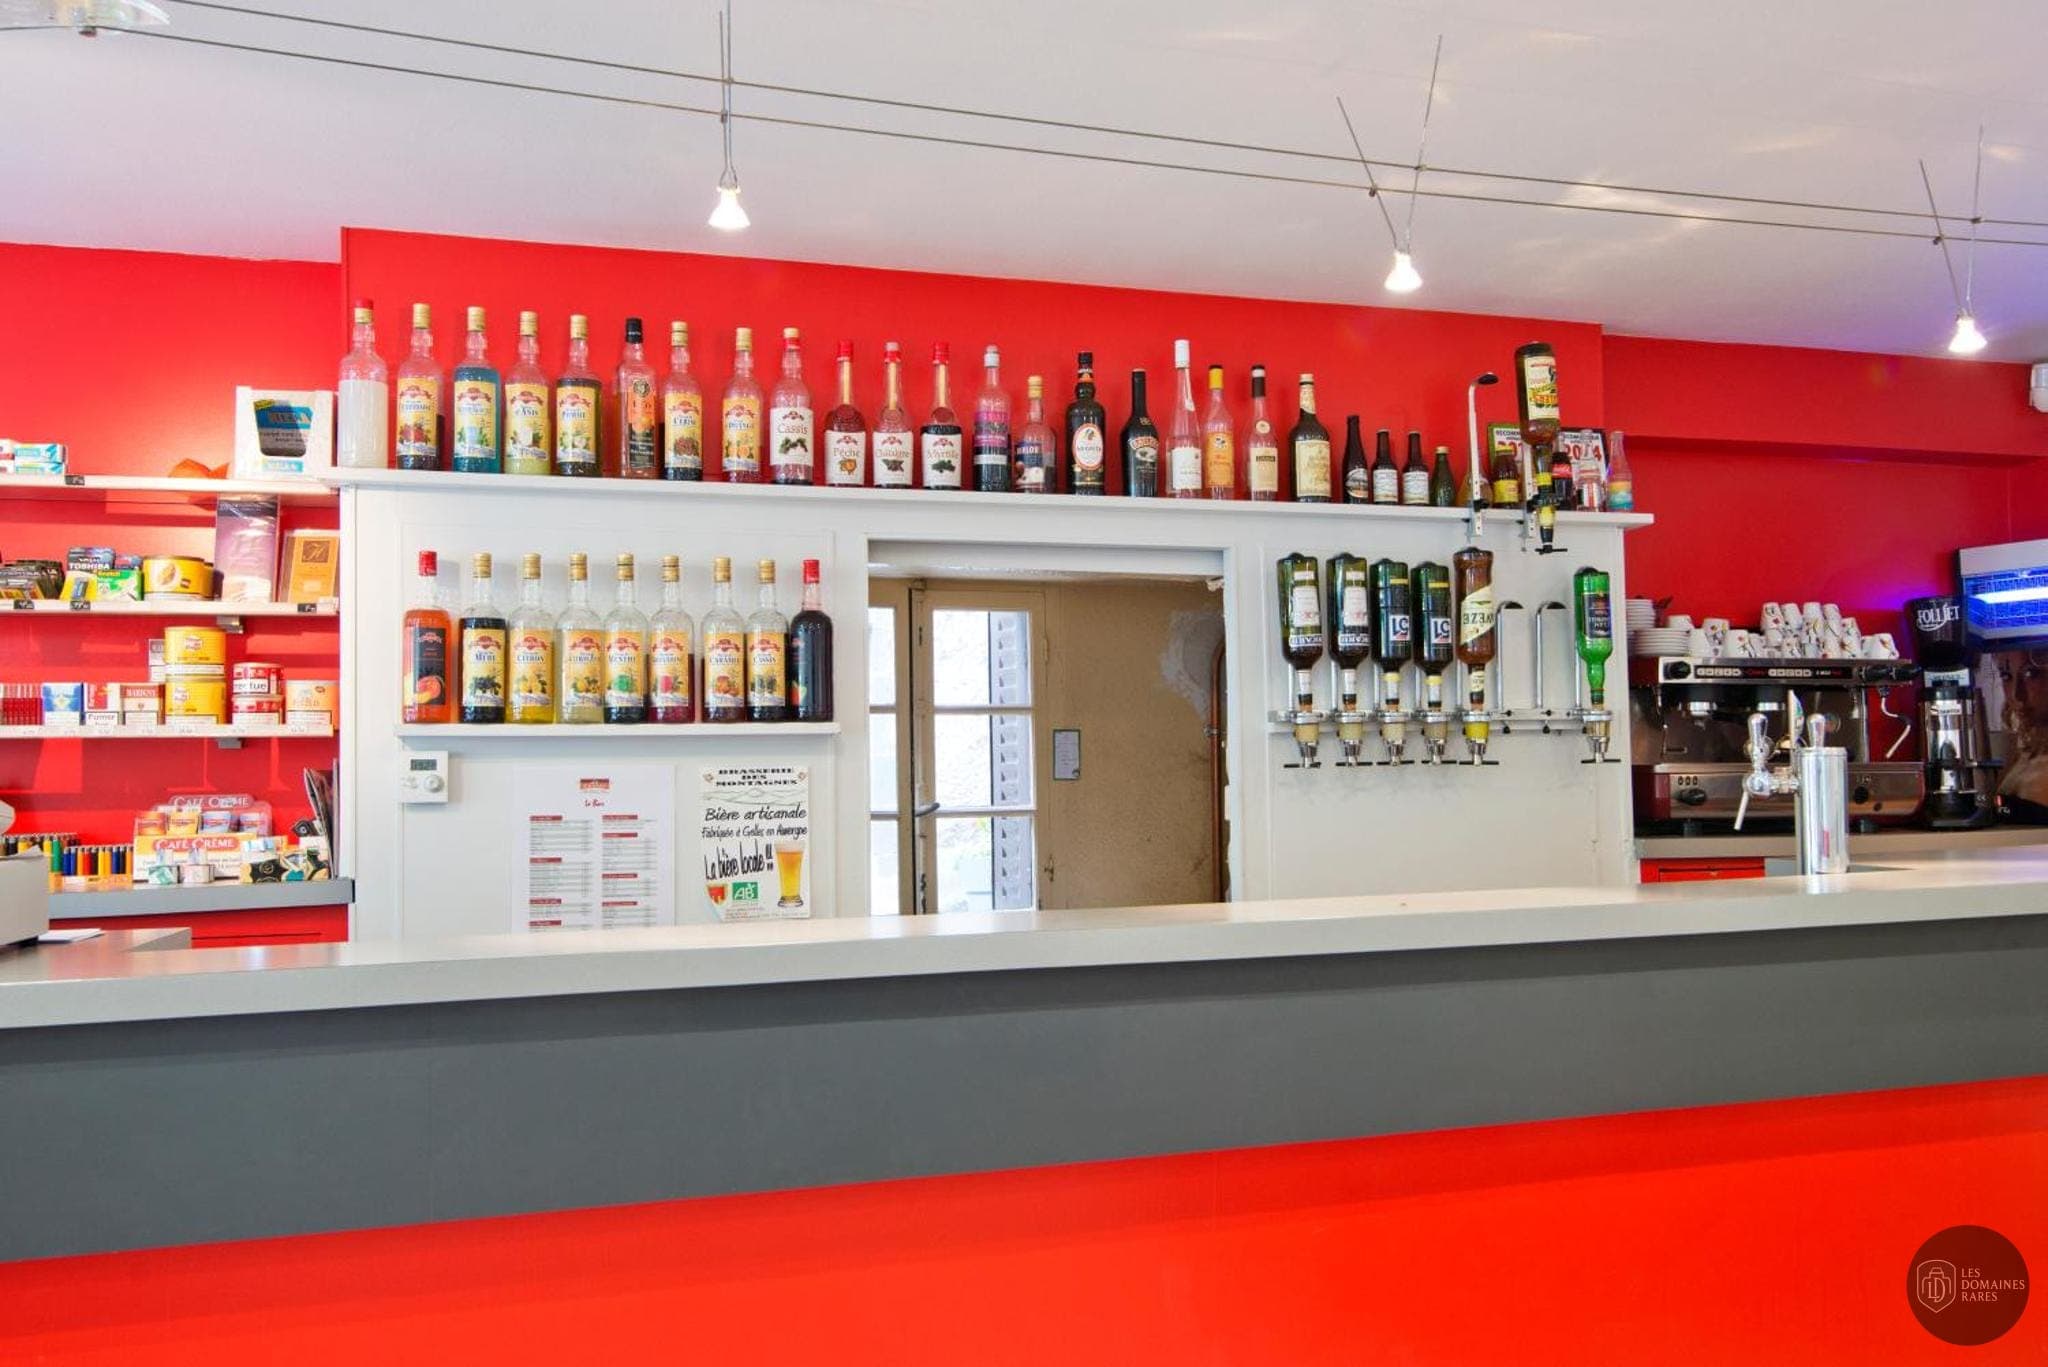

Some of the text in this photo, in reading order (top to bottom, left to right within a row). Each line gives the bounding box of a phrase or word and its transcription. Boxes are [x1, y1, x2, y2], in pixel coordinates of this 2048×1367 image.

[1392, 617, 1409, 637] 51
[1434, 620, 1450, 639] 51
[705, 806, 740, 821] Bière
[744, 802, 807, 820] artisanale
[704, 854, 717, 880] La
[734, 883, 757, 900] AB
